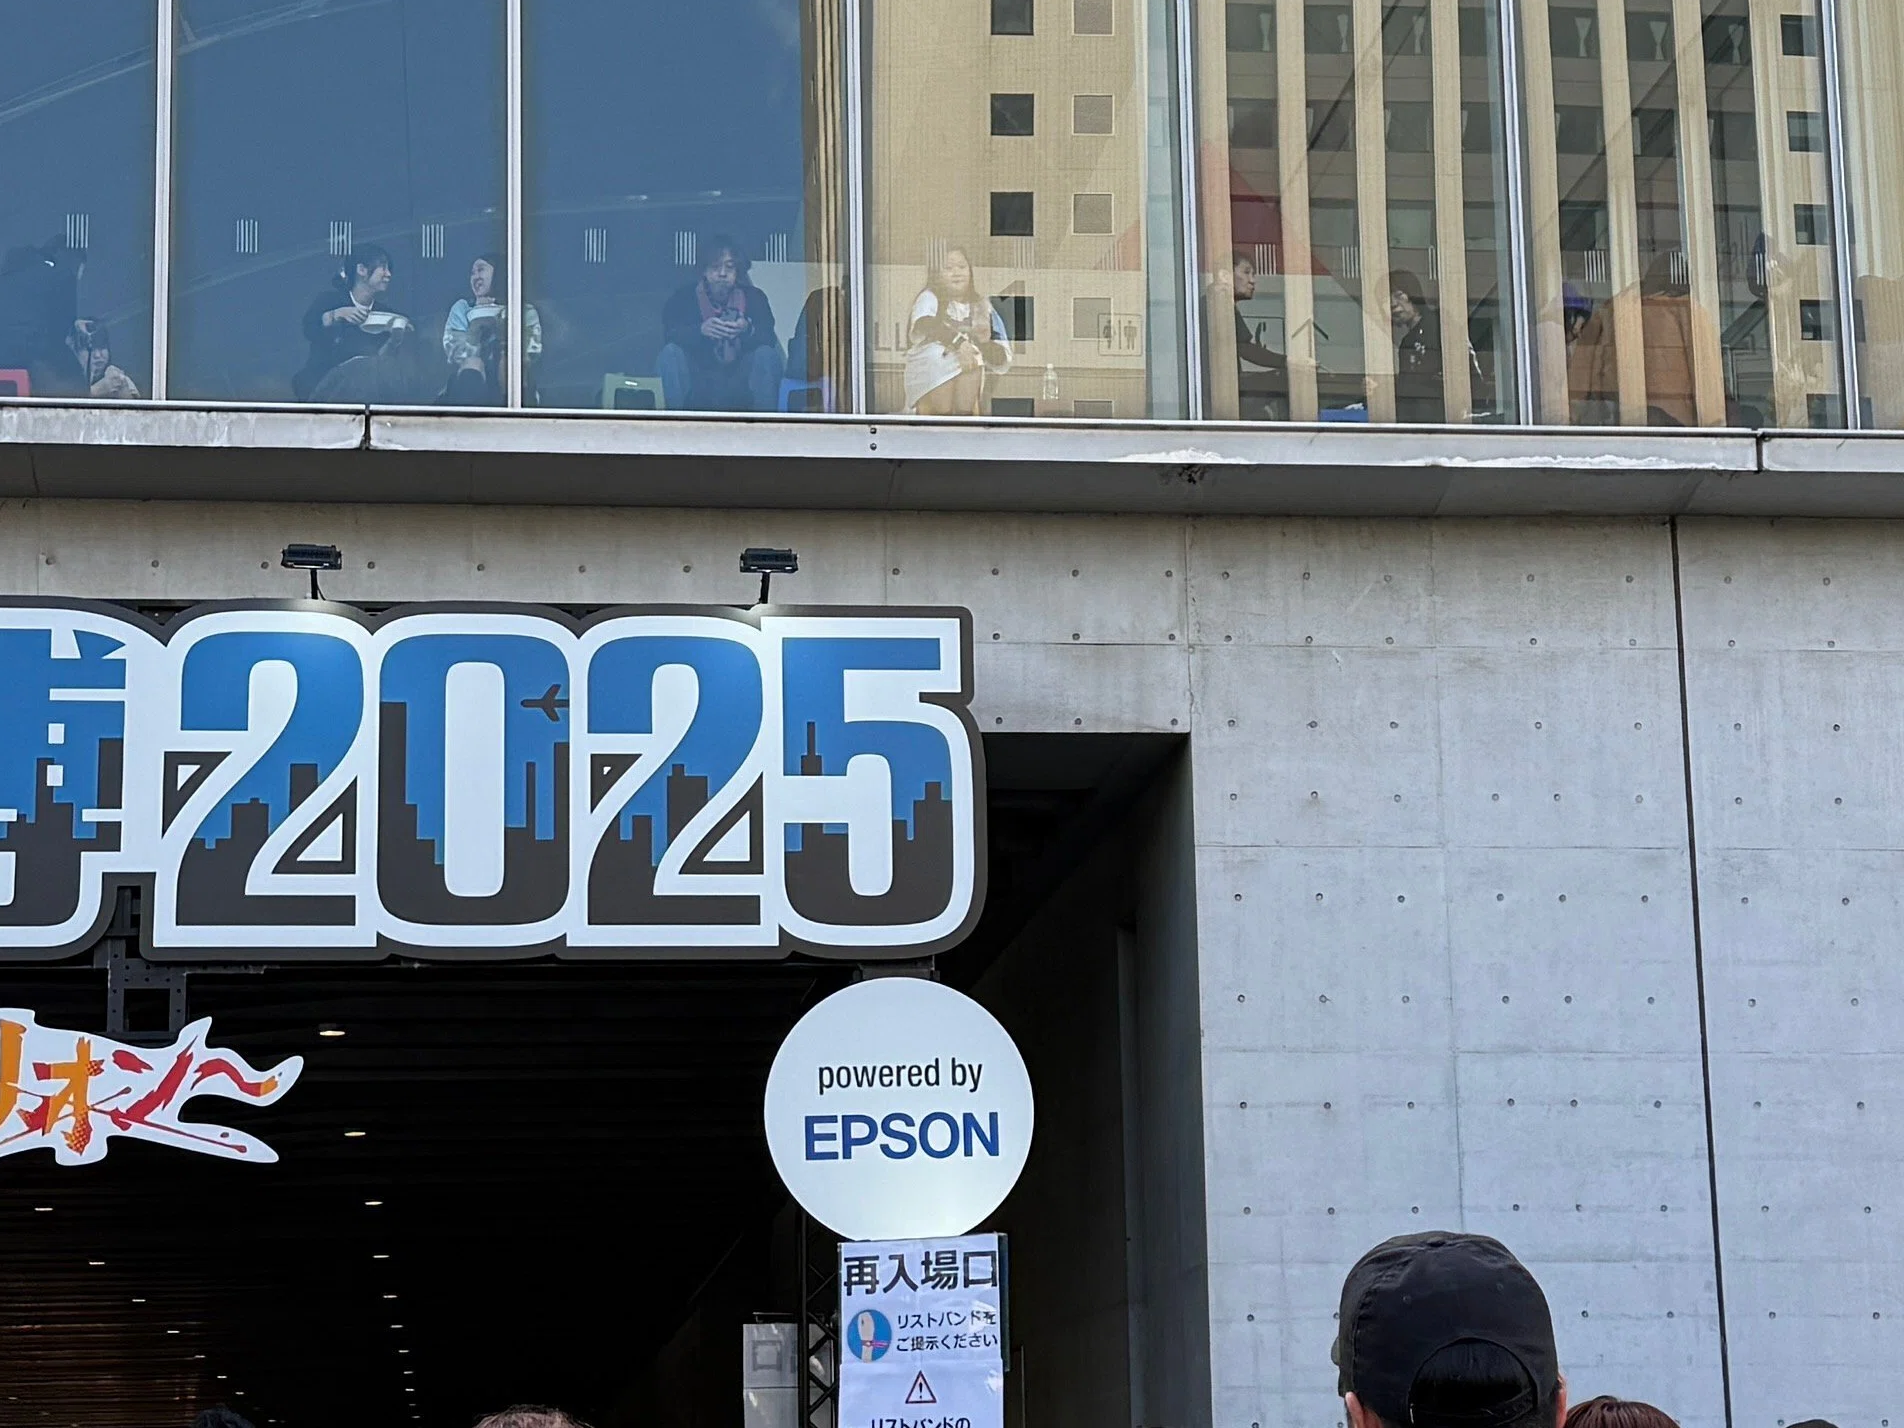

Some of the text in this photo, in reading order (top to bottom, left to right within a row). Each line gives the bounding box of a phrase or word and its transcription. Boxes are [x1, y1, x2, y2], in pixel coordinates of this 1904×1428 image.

[818, 1057, 983, 1095] powered by
[804, 1111, 1000, 1161] EPSON
[843, 1249, 997, 1296] 再入場口
[897, 1310, 997, 1329] リストバンドを
[896, 1334, 998, 1352] ご提示ください
